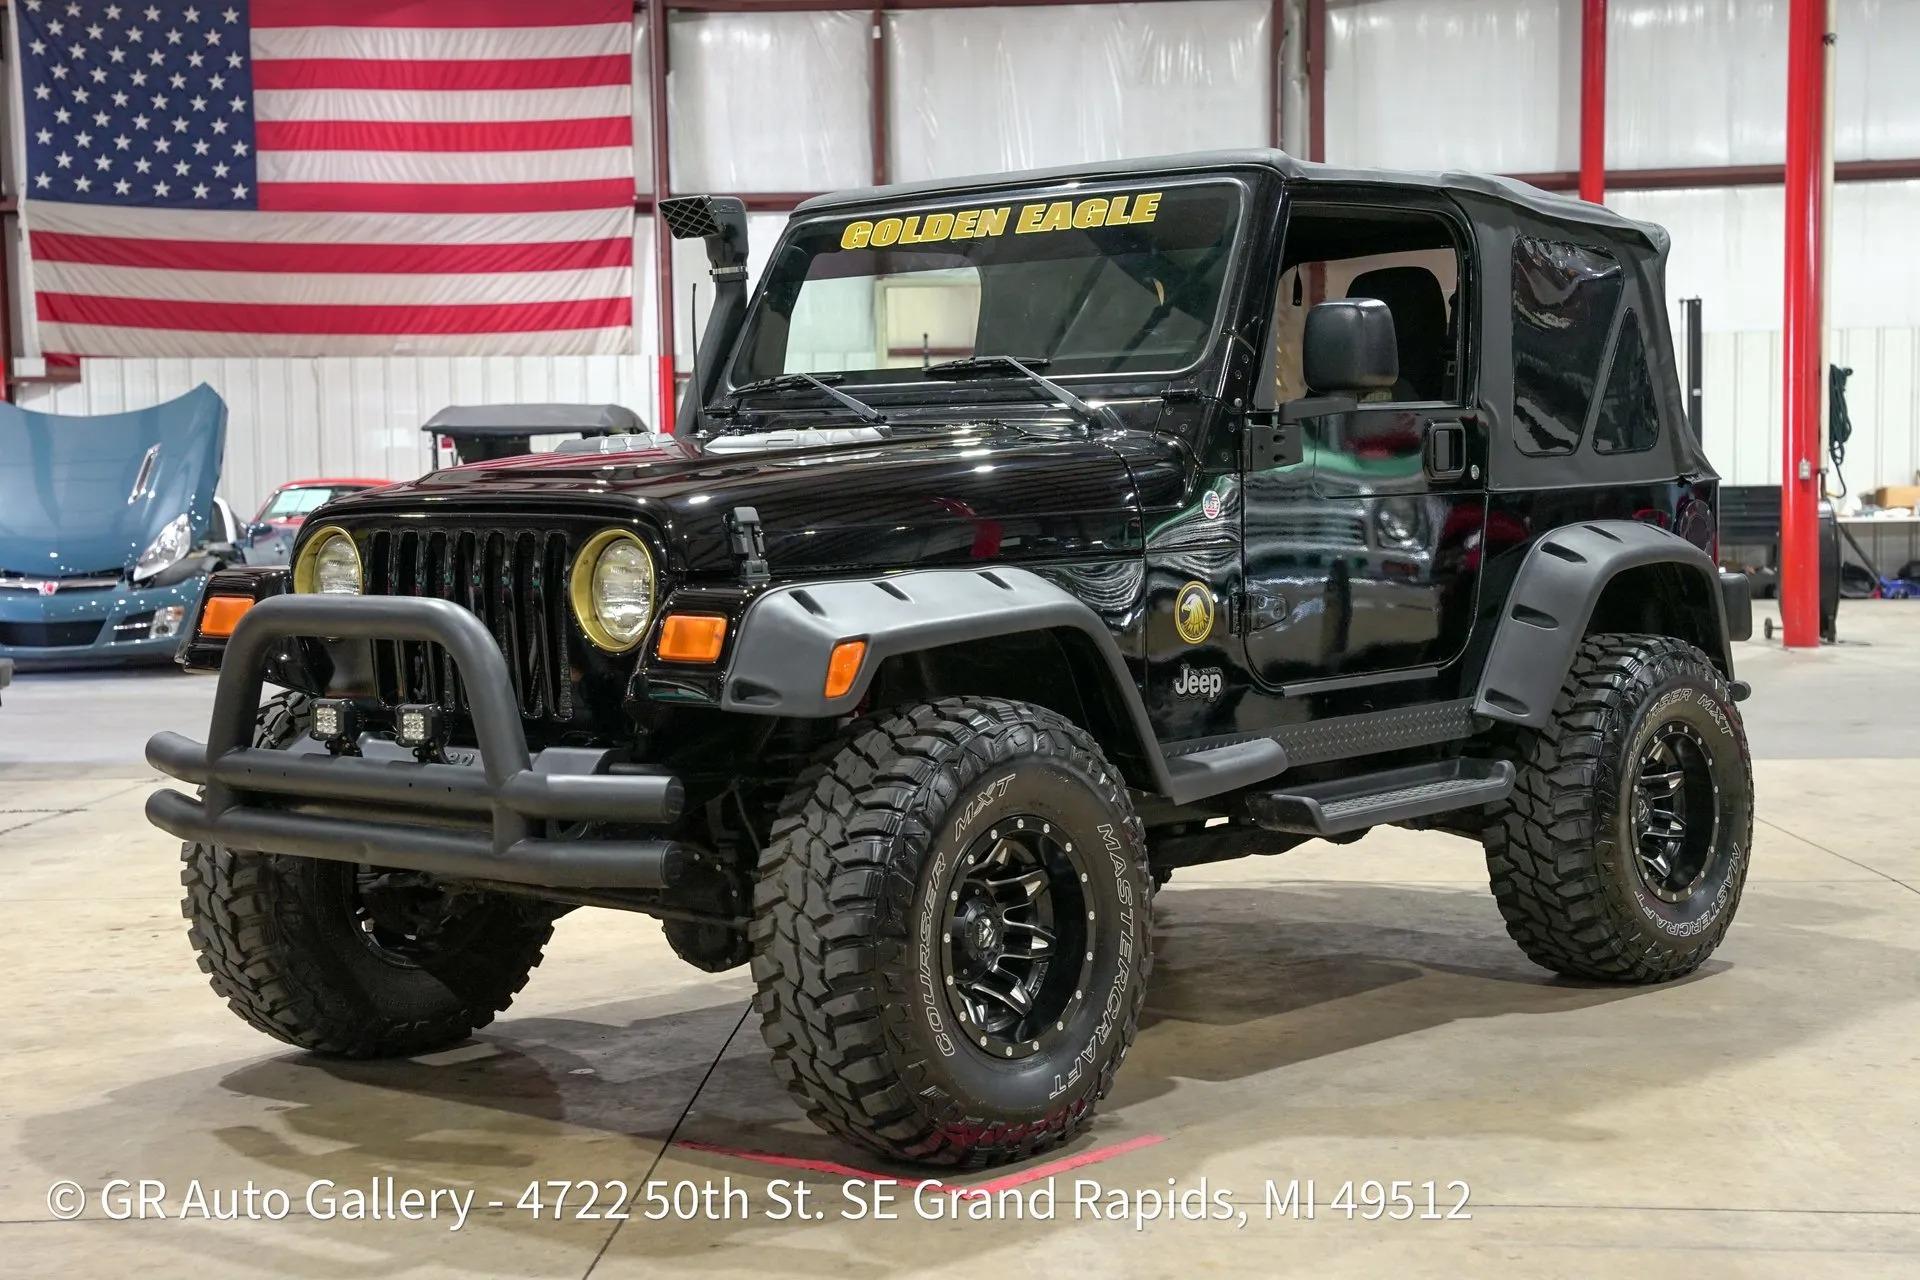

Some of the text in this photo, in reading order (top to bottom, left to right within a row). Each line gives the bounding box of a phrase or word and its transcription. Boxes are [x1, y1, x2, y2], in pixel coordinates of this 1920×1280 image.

[840, 192, 1163, 250] GOLDEN EAGLE
[1175, 664, 1222, 698] Jeep
[1697, 693, 1734, 738] MXT
[917, 772, 1017, 1058] COURSER MXT
[1632, 841, 1742, 938] MASTERCRAFT
[1048, 822, 1134, 1101] MASTERCRAFT
